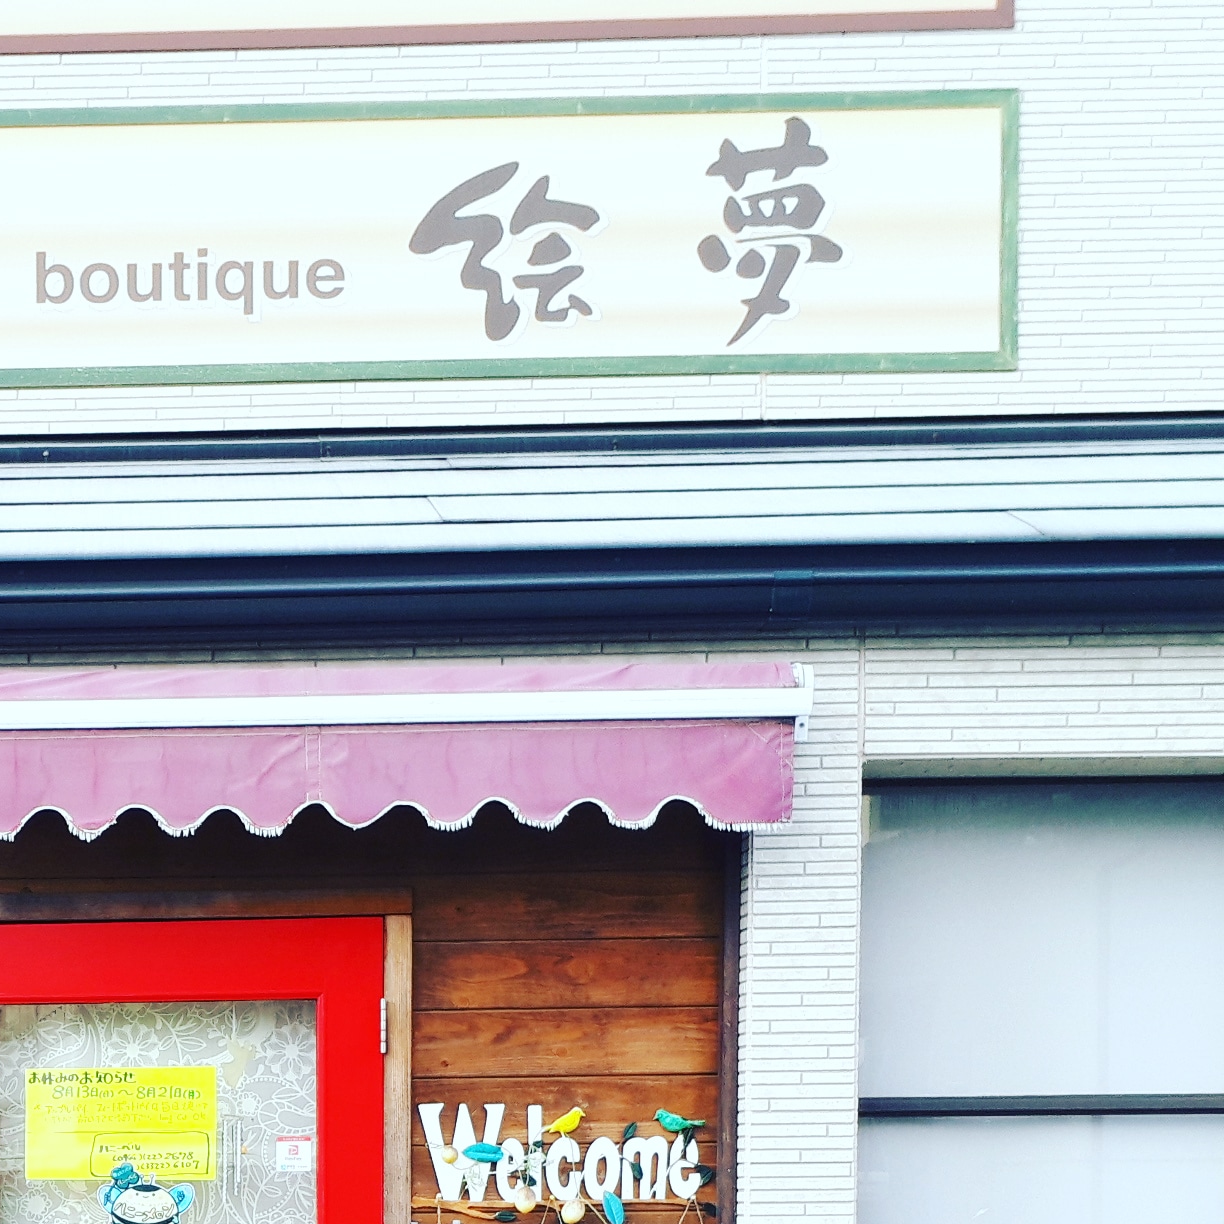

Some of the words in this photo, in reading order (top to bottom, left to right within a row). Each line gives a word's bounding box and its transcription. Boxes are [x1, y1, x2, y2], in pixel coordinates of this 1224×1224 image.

[409, 116, 844, 346] 絵夢
[35, 248, 346, 317] boutique
[417, 1102, 702, 1201] Welcome
